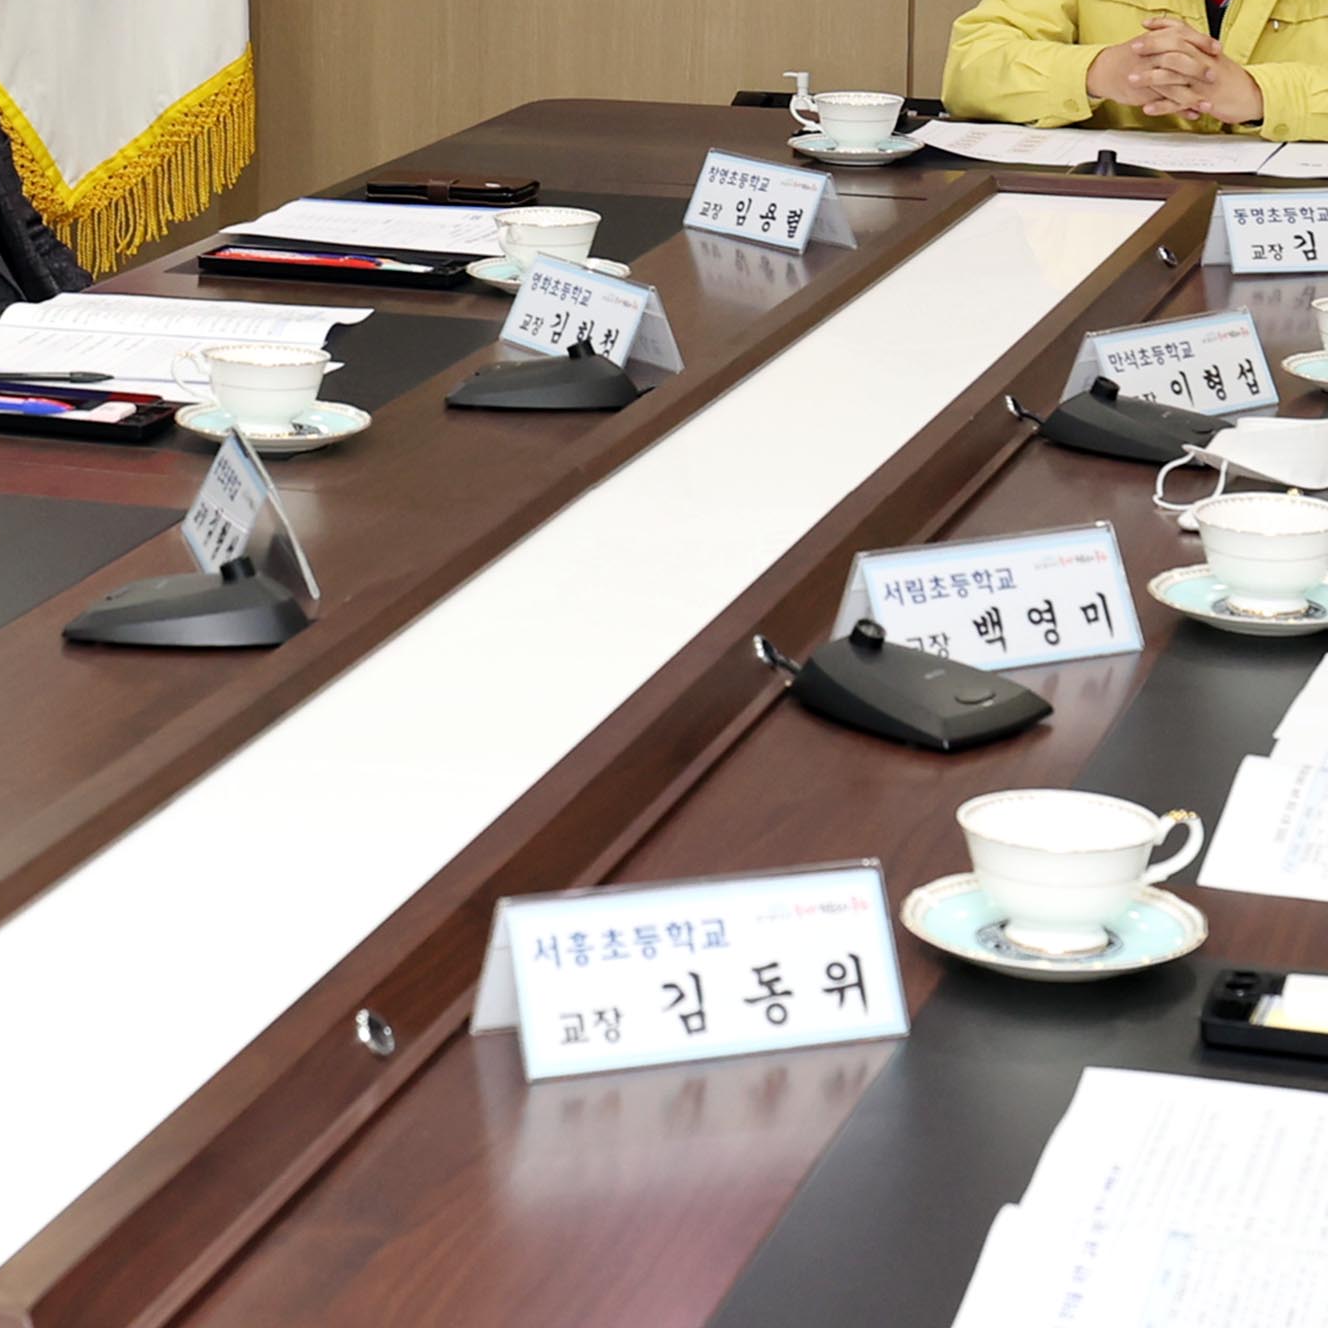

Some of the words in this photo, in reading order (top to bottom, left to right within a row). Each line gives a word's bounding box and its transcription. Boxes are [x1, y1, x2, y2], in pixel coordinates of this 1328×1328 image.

[708, 166, 771, 193] 창영초등학교
[699, 201, 723, 221] 교장
[1250, 243, 1284, 261] 교장
[519, 313, 545, 336] 교장
[1107, 340, 1196, 374] 만석초등학교
[882, 567, 1018, 607] 서림초등학교
[533, 916, 732, 969] 서흥초등학교
[558, 1005, 625, 1047] 교장
